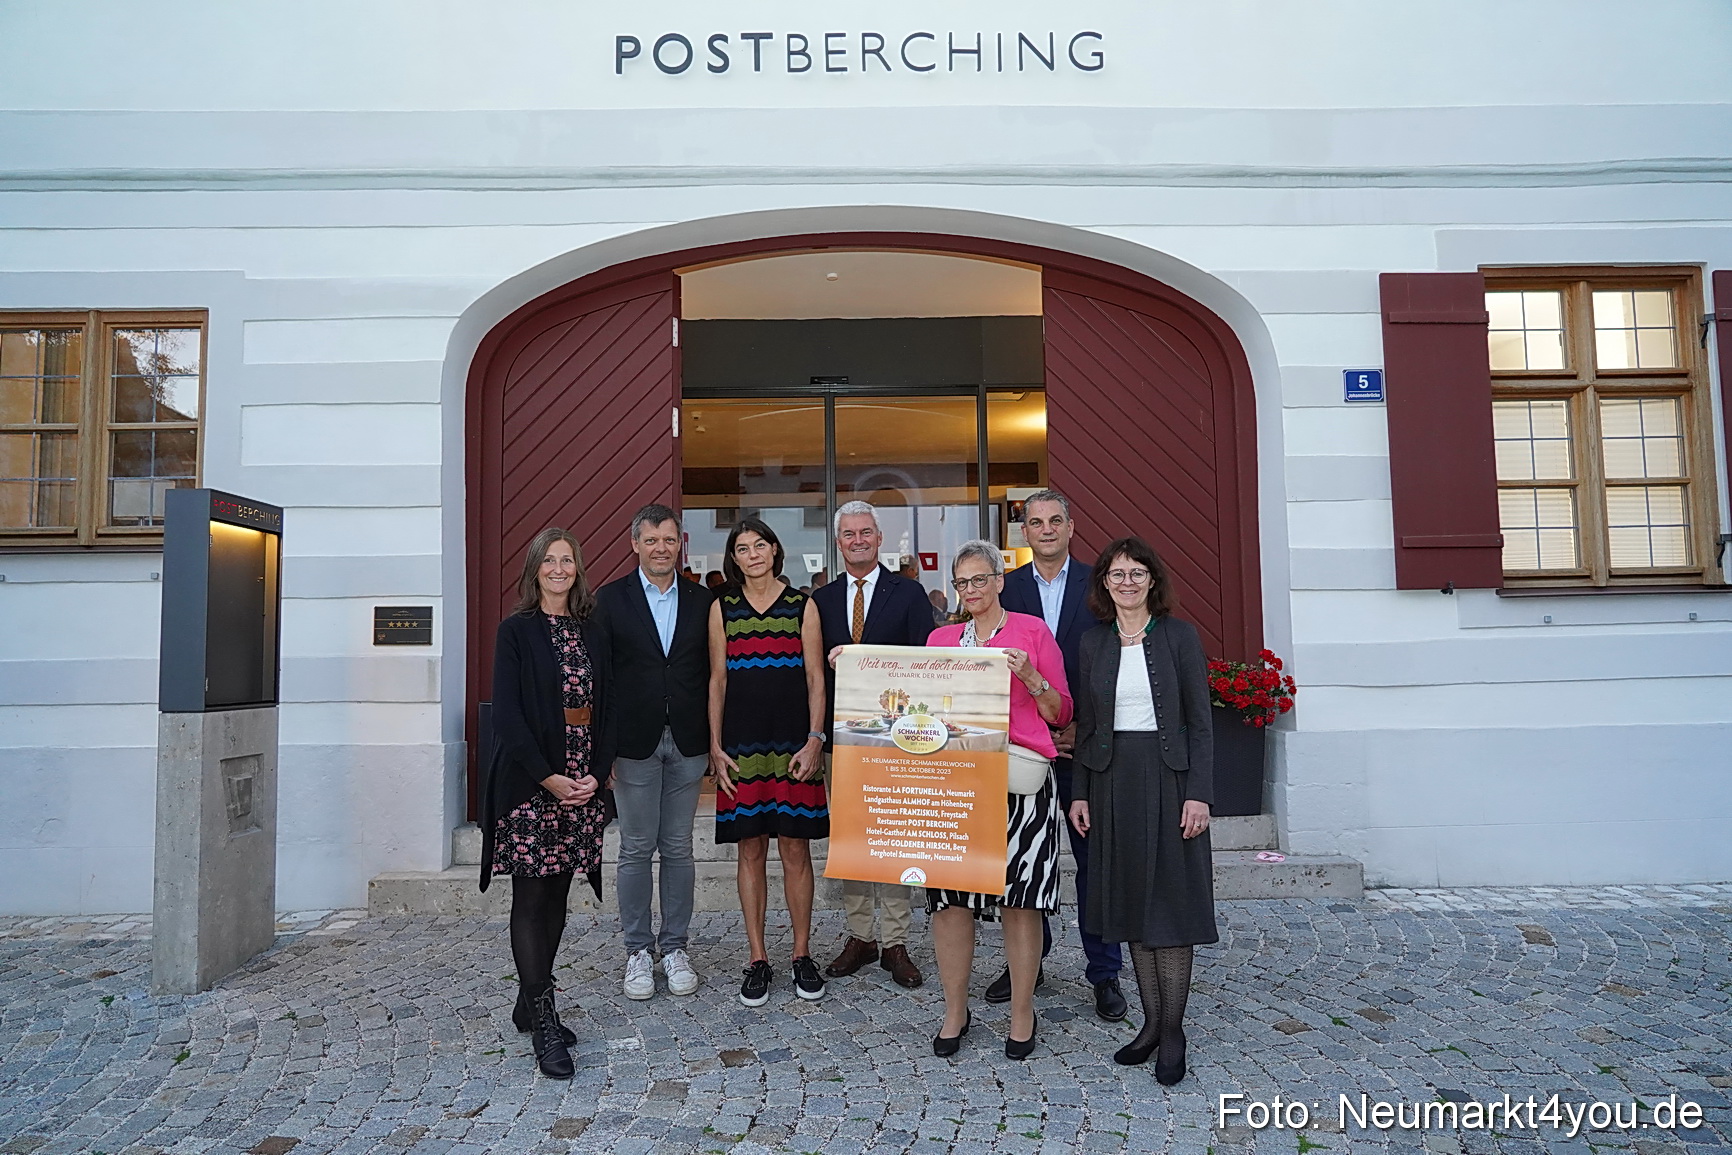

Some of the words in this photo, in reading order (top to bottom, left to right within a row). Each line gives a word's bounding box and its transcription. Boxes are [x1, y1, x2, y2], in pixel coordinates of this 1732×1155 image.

[1358, 374, 1368, 388] 5
[858, 657, 878, 670] Weit
[910, 660, 928, 670] und
[929, 658, 951, 671] doch
[911, 760, 976, 768] SCHMANKERLWOCHEN
[863, 785, 891, 793] Ristorante
[902, 787, 945, 797] FORTUNELLA,
[946, 789, 975, 797] Neumarkt
[864, 796, 901, 805] Landgasthaus
[903, 798, 930, 806] ALMHOF
[941, 800, 973, 810] Höhenberg
[869, 806, 898, 815] Restaurant
[900, 808, 940, 818] FRANZISKUS,
[941, 810, 968, 820] Freystadt
[877, 817, 907, 826] Restaurant
[908, 819, 925, 827] POST
[926, 820, 958, 829] BERCHING
[866, 828, 906, 837] Hotel-Gasthof
[918, 831, 948, 840] SCHLOSS,
[950, 832, 969, 840] Pilsach
[868, 838, 890, 847] Gasthof
[891, 840, 925, 848] GOLDENER
[926, 842, 952, 851] HIRSCH,
[953, 843, 967, 853] Berg
[870, 849, 898, 859] Berghotel
[899, 851, 932, 861] Sammüller,
[934, 853, 962, 862] Neumarkt
